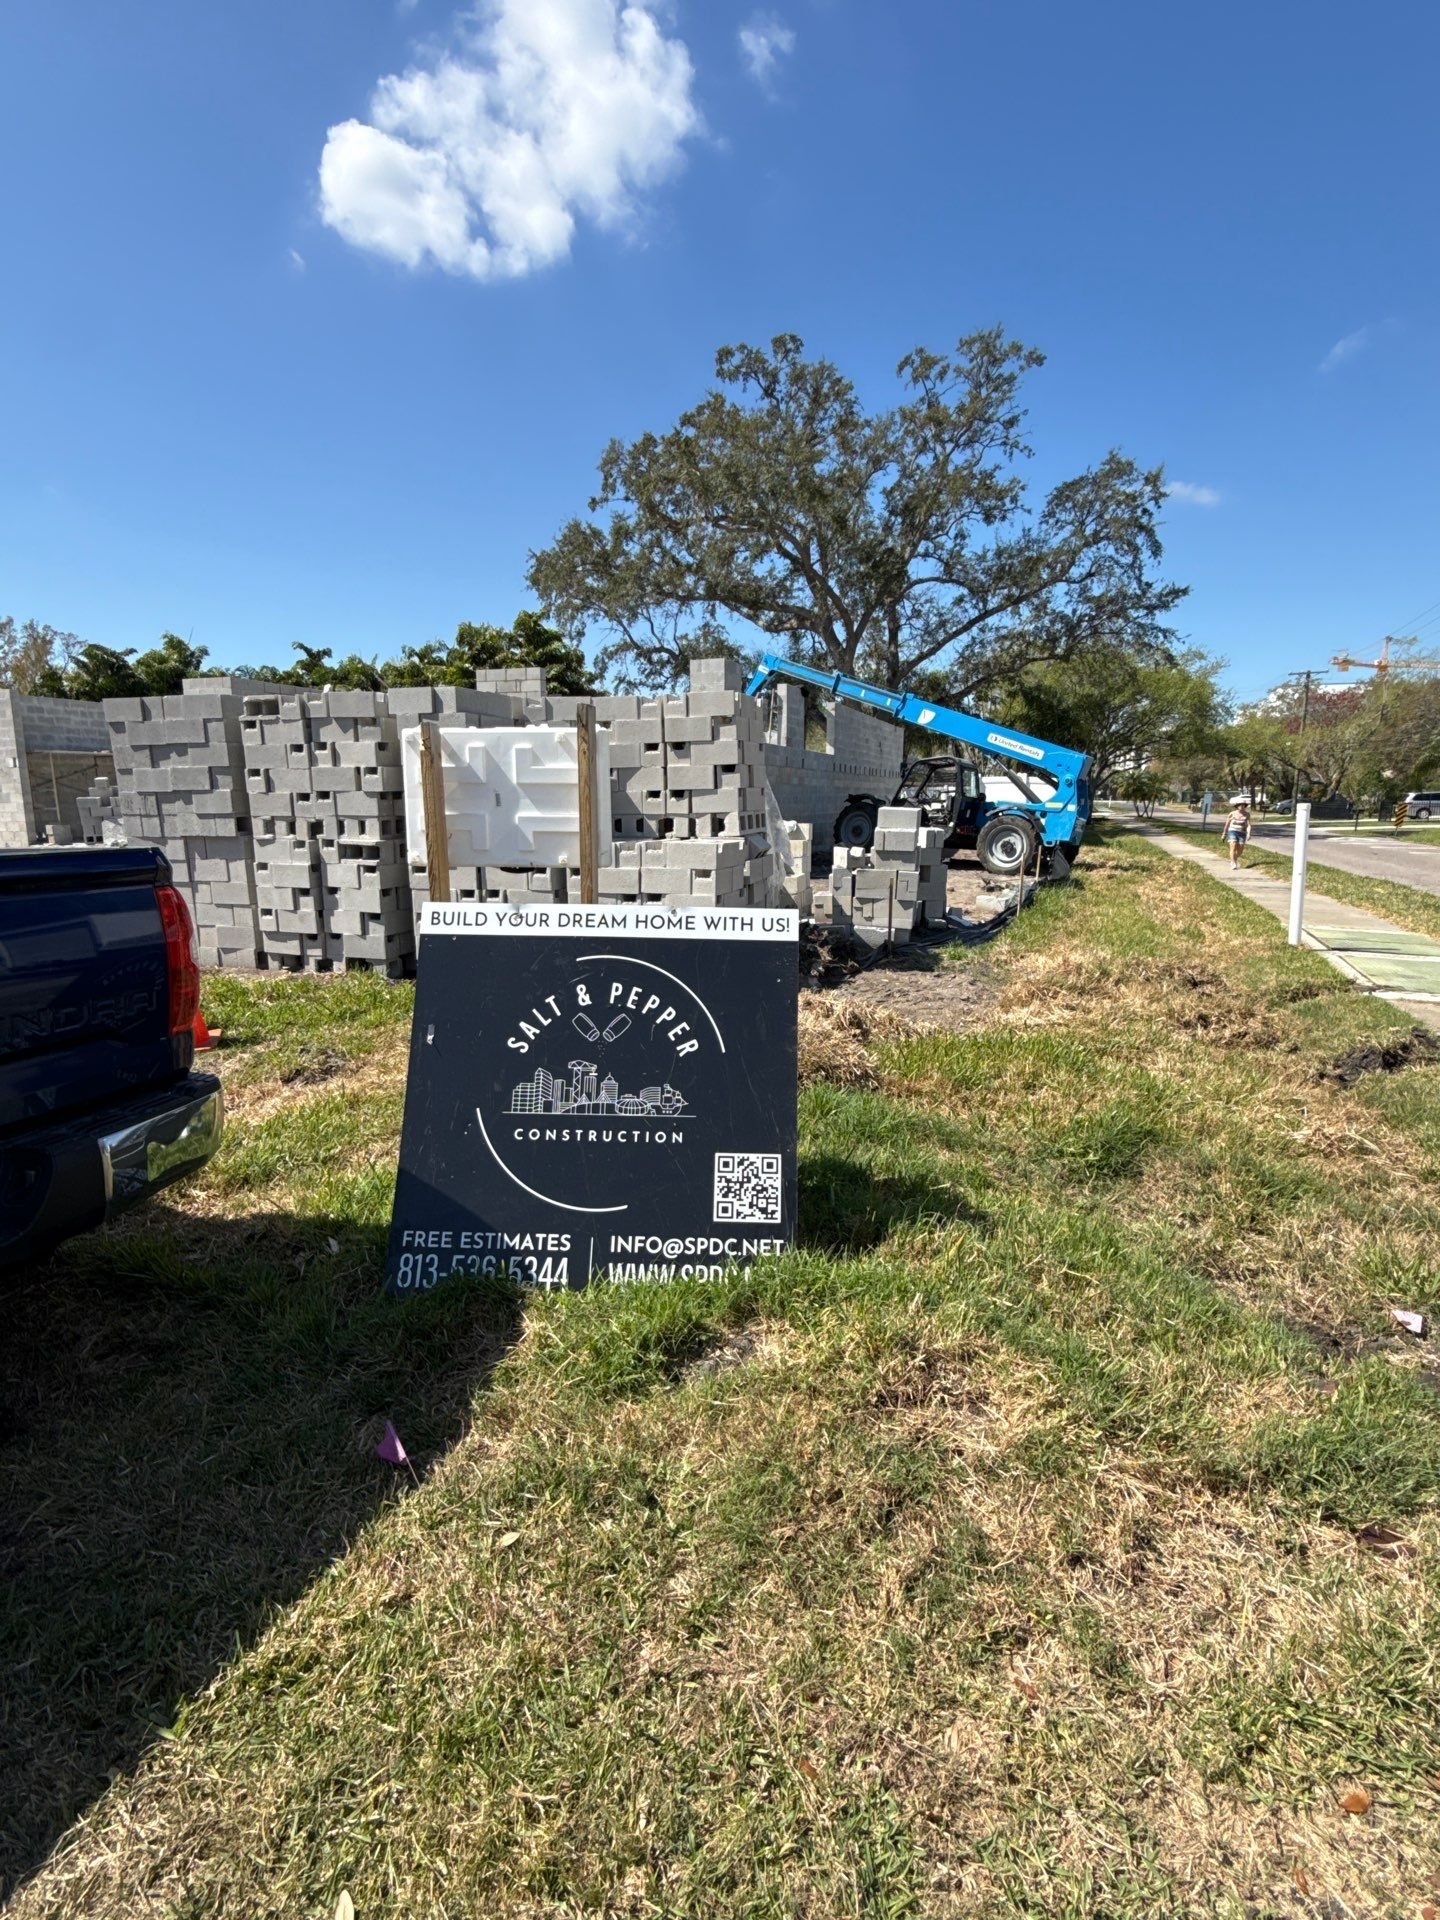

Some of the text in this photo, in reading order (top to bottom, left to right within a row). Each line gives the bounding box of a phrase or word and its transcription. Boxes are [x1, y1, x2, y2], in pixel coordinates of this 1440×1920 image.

[430, 911, 790, 932] BUILD YOUR DREAM HOME WITH US!
[507, 982, 699, 1057] SALT & PEPPER
[514, 1128, 683, 1144] CONSTRUCTION
[402, 1230, 572, 1251] FREE ESTIMATES
[610, 1235, 784, 1259] INFO@SPDC.NET
